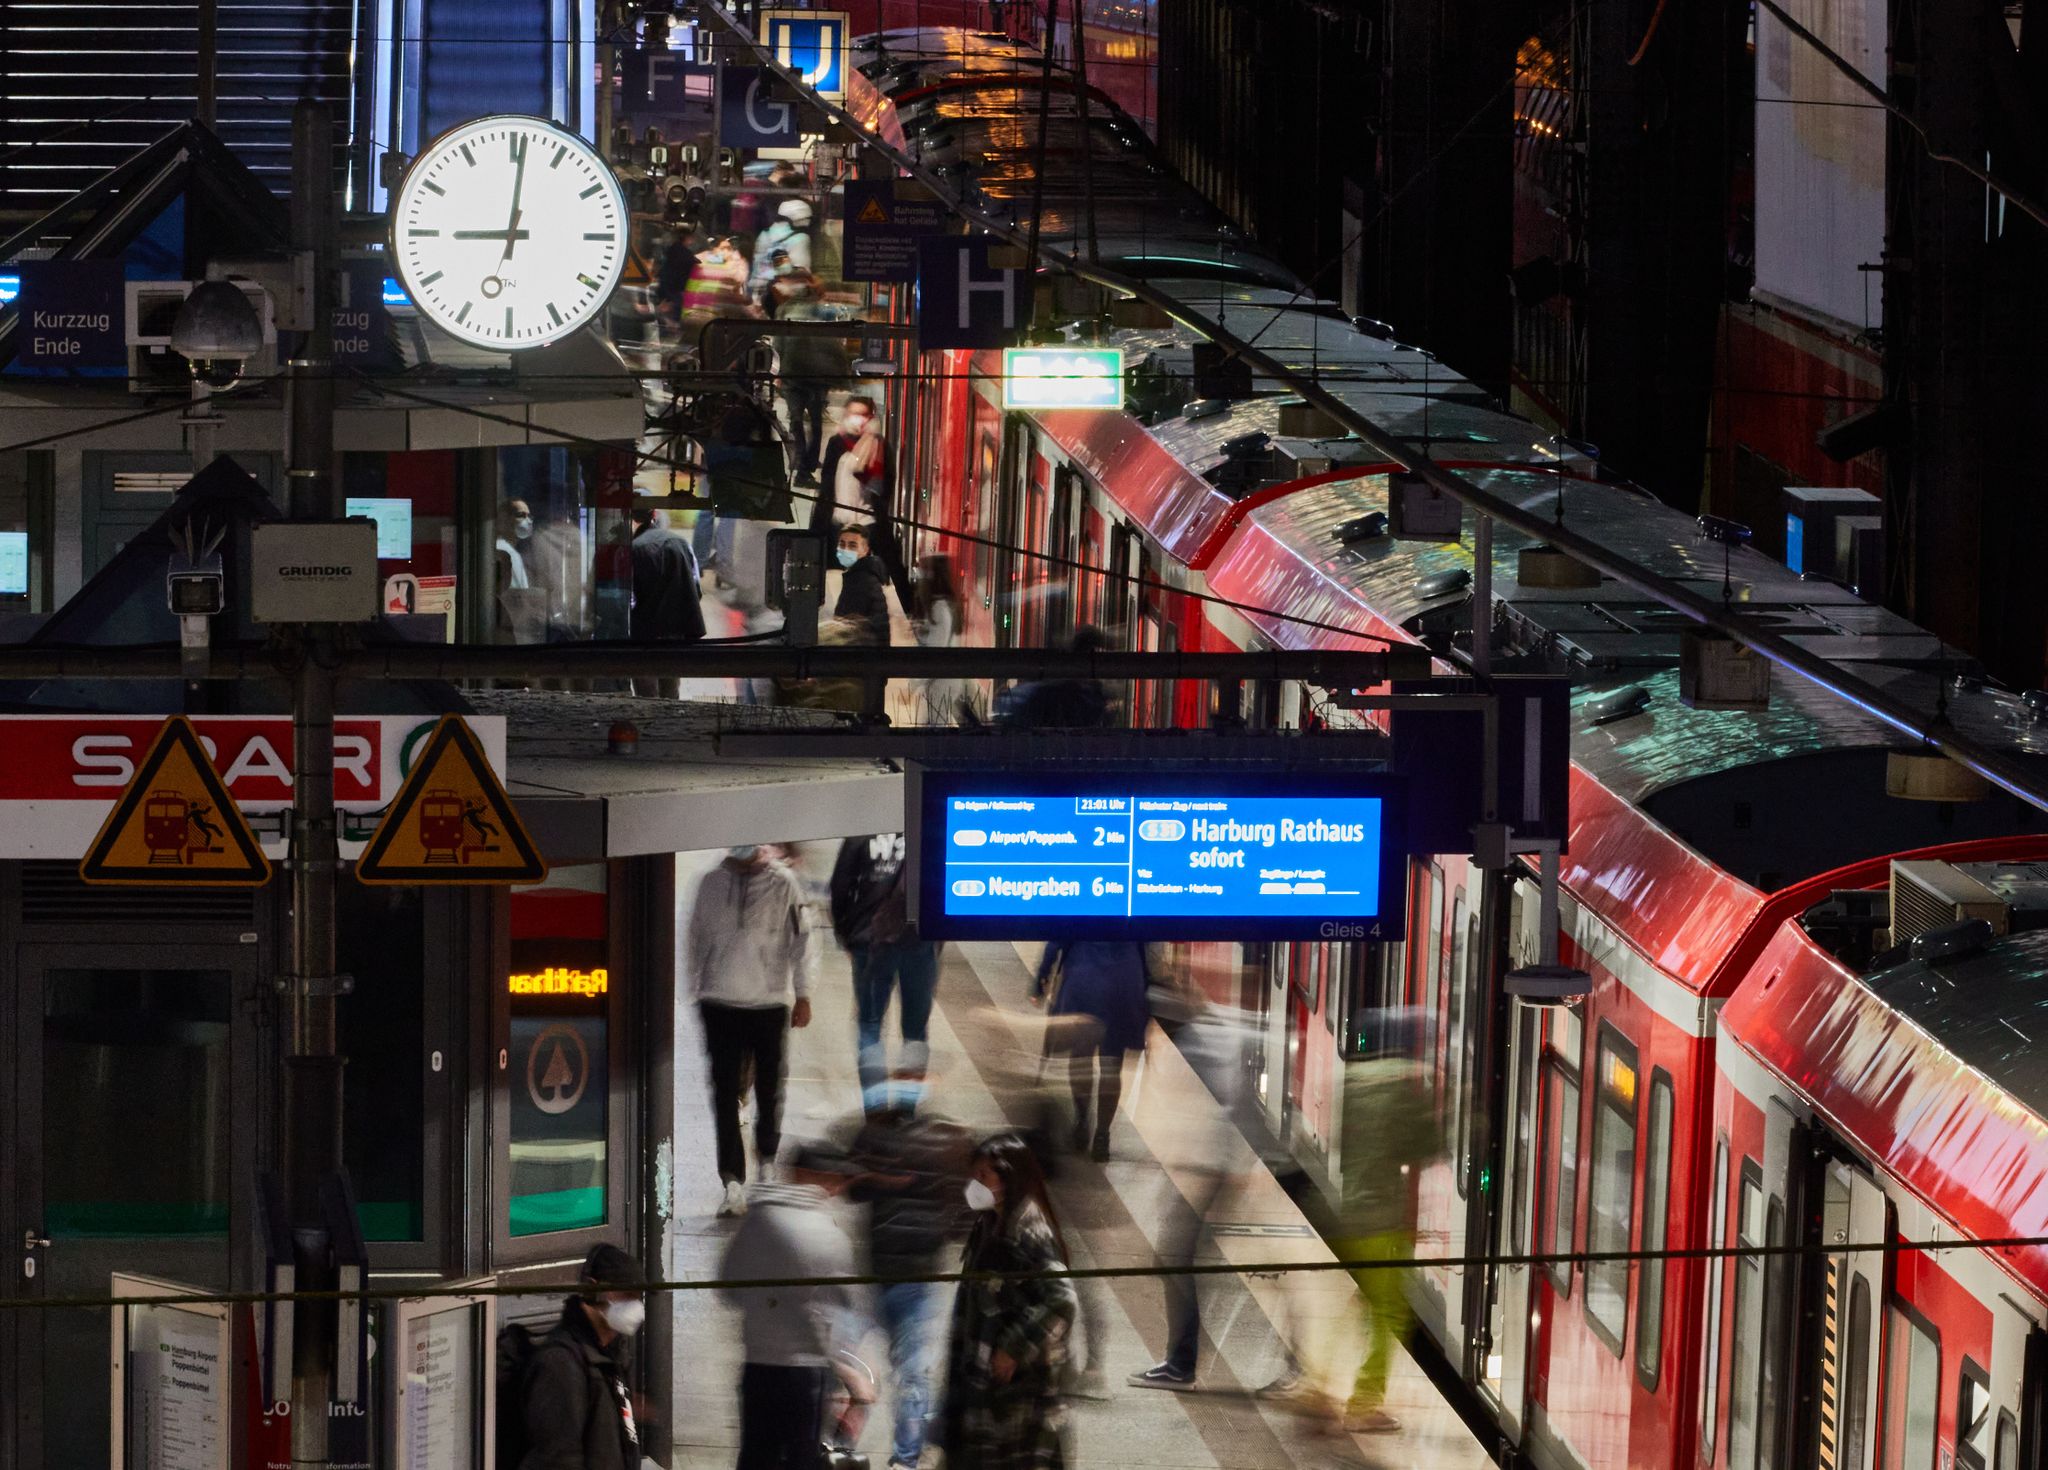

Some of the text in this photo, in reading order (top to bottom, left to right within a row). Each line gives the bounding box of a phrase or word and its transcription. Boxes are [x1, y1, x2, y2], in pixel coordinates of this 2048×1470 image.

[778, 24, 832, 86] U
[648, 56, 675, 101] F
[745, 77, 789, 134] G
[958, 248, 1014, 328] H
[34, 311, 109, 331] Kurzzug
[34, 338, 80, 354] Ende
[279, 567, 352, 576] GRUNDIG
[72, 735, 372, 787] SAR
[1082, 800, 1125, 810] 21:01 Uhr
[1094, 827, 1105, 845] 2
[1107, 833, 1125, 844] Min
[1192, 819, 1275, 846] Harburg
[1281, 819, 1363, 841] Rathaus
[1190, 847, 1244, 867] sofort
[989, 877, 1080, 901] Neugraben
[1093, 877, 1104, 896] 6
[1106, 882, 1124, 894] Min
[1321, 922, 1381, 936] Gleis 4
[267, 1462, 371, 1470] Notru formation
